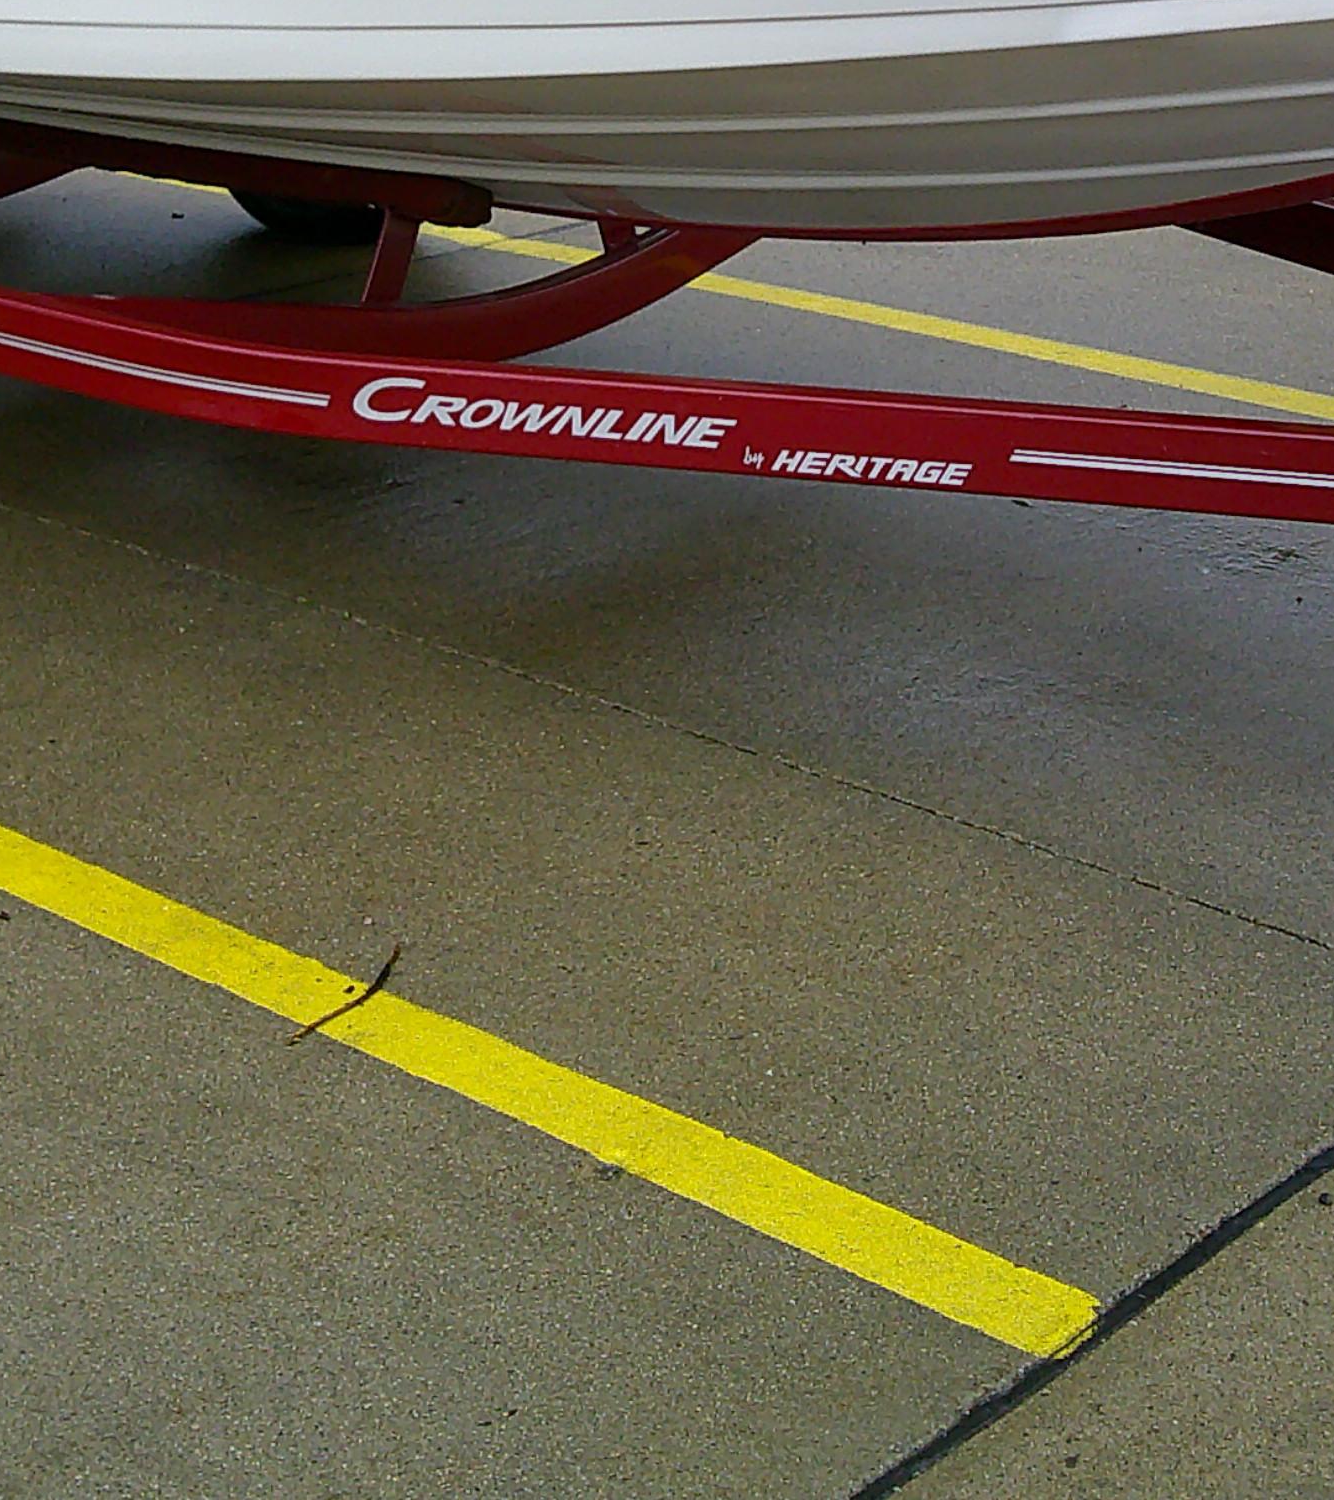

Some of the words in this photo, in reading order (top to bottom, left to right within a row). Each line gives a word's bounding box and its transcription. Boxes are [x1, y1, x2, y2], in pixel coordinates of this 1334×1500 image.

[352, 376, 737, 449] CROWNLINE
[742, 445, 765, 470] by
[770, 449, 973, 486] HERITAGE
